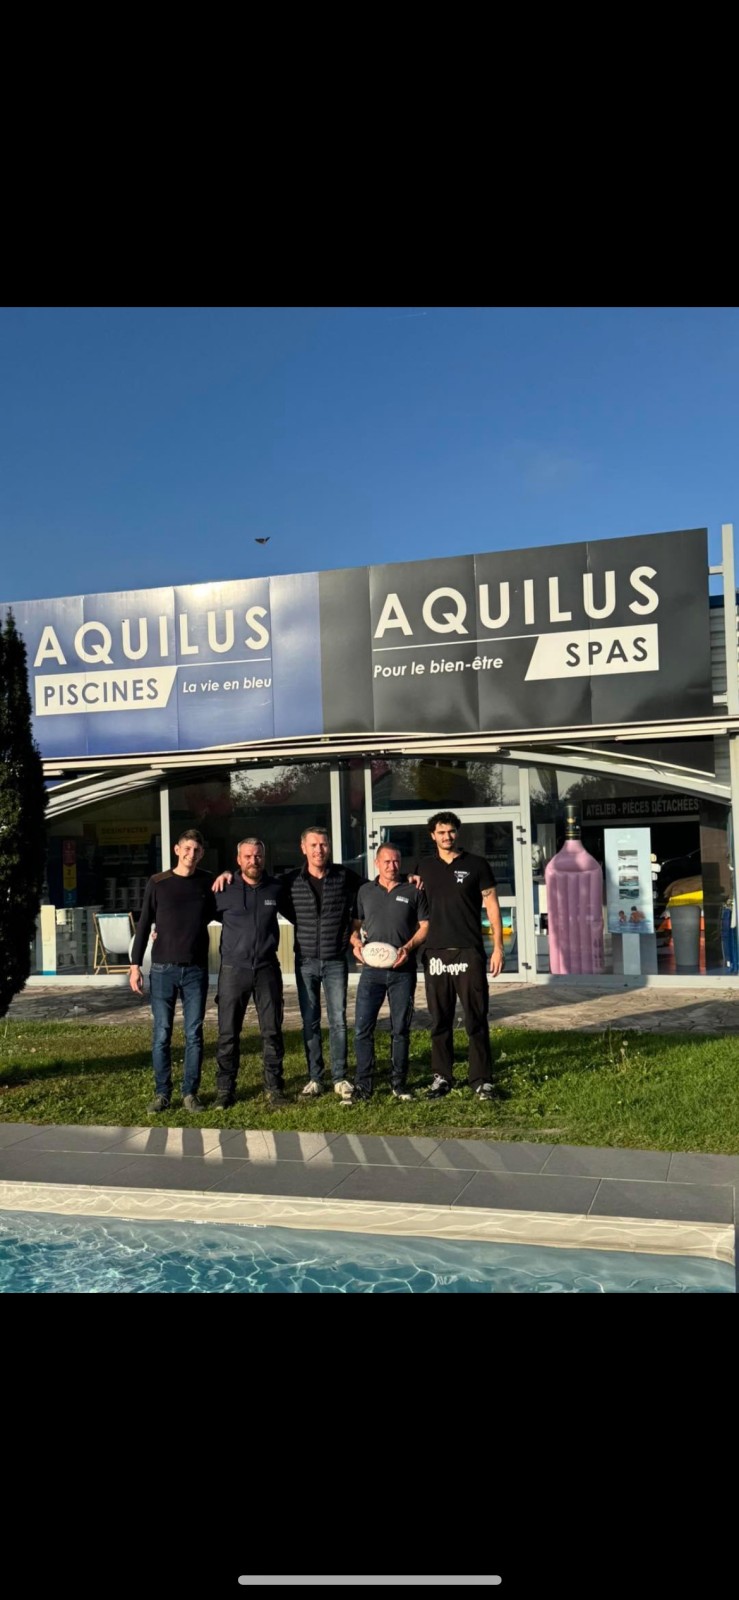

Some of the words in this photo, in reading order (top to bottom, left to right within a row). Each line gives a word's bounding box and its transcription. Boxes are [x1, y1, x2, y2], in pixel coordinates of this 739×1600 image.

[373, 565, 659, 639] AQUILUS
[34, 605, 270, 667] AQUILUS
[566, 636, 648, 667] SPAS
[373, 663, 406, 679] Pour
[411, 660, 425, 676] le
[430, 655, 504, 674] bien-être
[44, 677, 159, 707] PISCINES
[182, 680, 198, 694] La
[200, 678, 220, 692] vie
[223, 680, 239, 691] en
[243, 676, 272, 690] bleu
[586, 803, 616, 816] ATELIER
